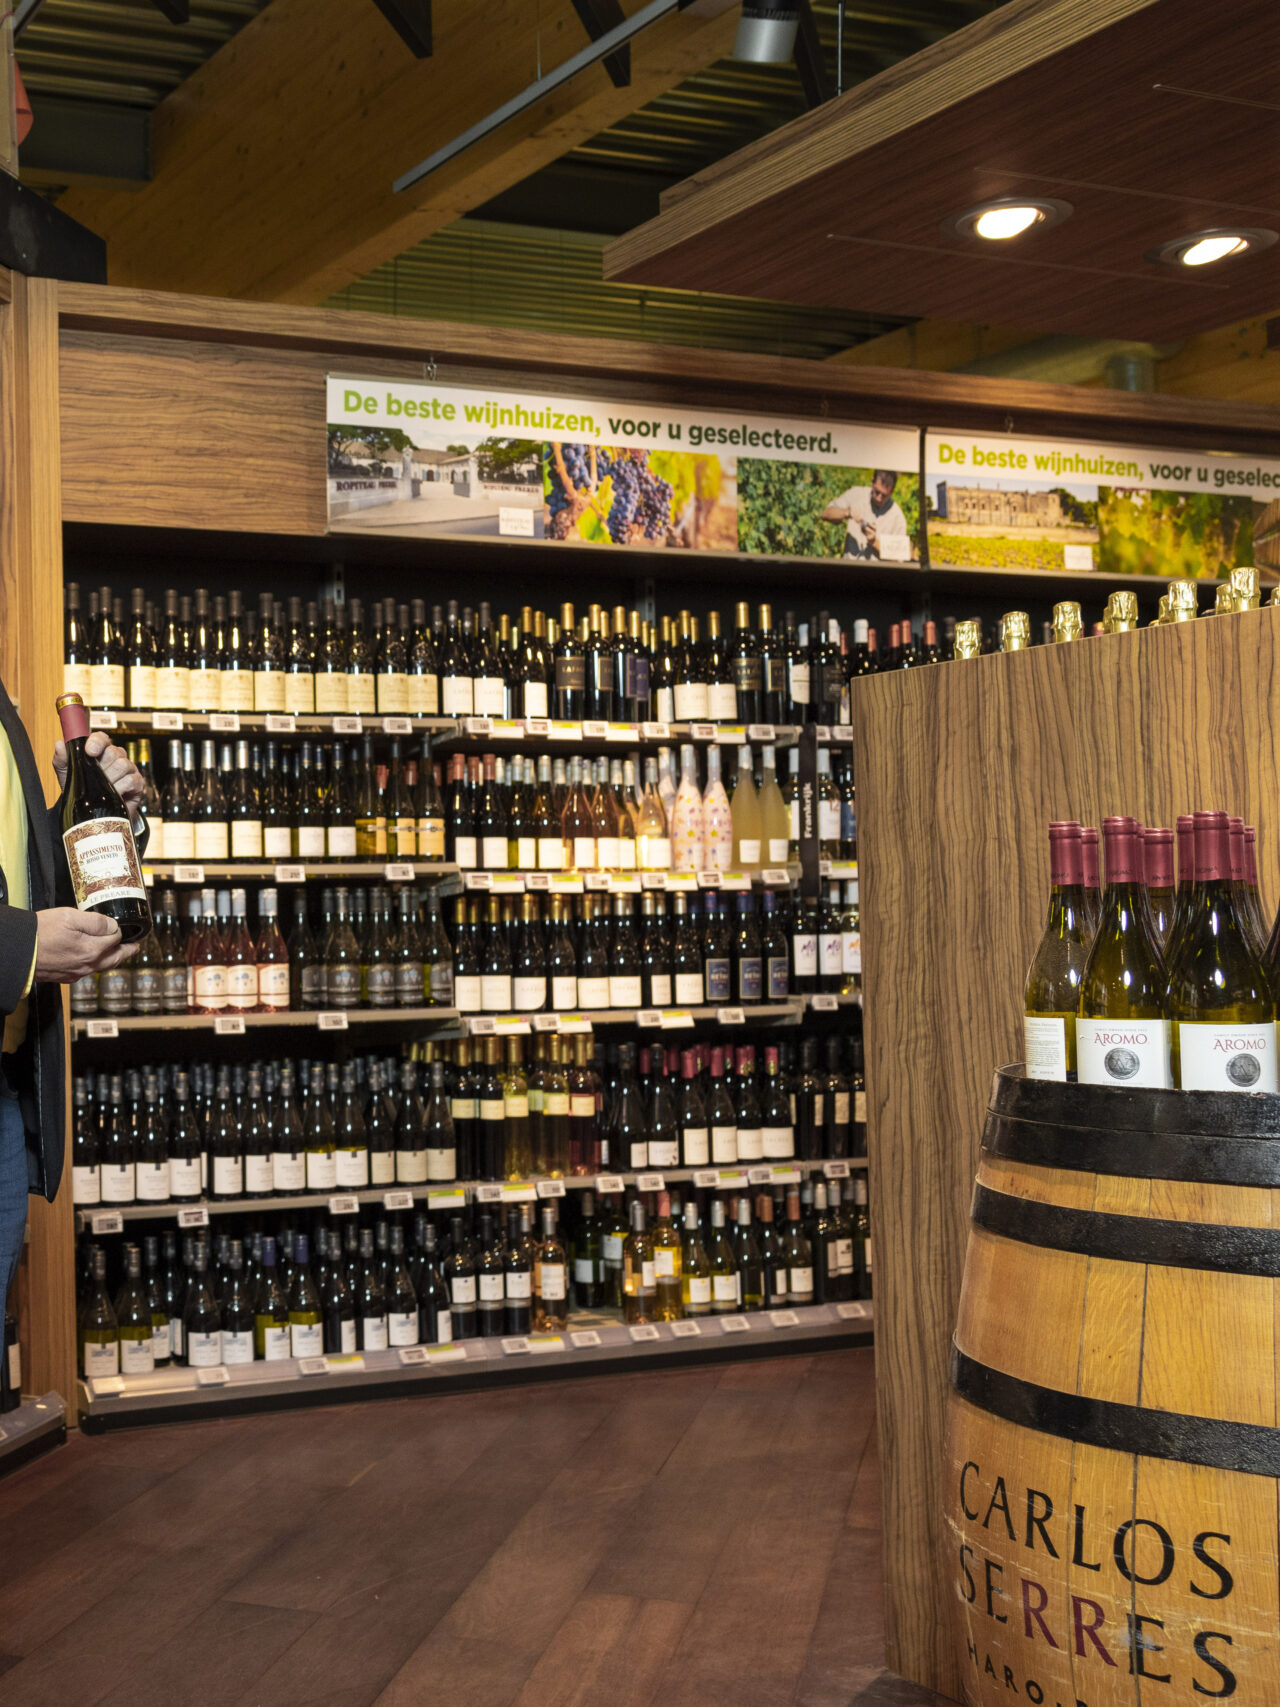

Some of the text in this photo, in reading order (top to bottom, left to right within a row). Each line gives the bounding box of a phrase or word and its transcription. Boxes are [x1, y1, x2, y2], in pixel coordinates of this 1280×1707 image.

[343, 389, 838, 455] De beste wijnhuizen, voor u geselecteerd.
[938, 443, 966, 464] De
[972, 445, 1028, 469] beste
[1034, 452, 1144, 482] wijnhuizen,
[1149, 463, 1191, 483] voor
[1197, 466, 1209, 483] u
[803, 782, 813, 840] Frankrijk
[79, 844, 123, 860] APPASSIMENTO
[1094, 1032, 1148, 1047] AROMO
[1212, 1038, 1266, 1053] AROMO
[959, 1460, 1235, 1600] CARLOS
[957, 1543, 1238, 1698] SERRES
[967, 1637, 1044, 1705] HARO
